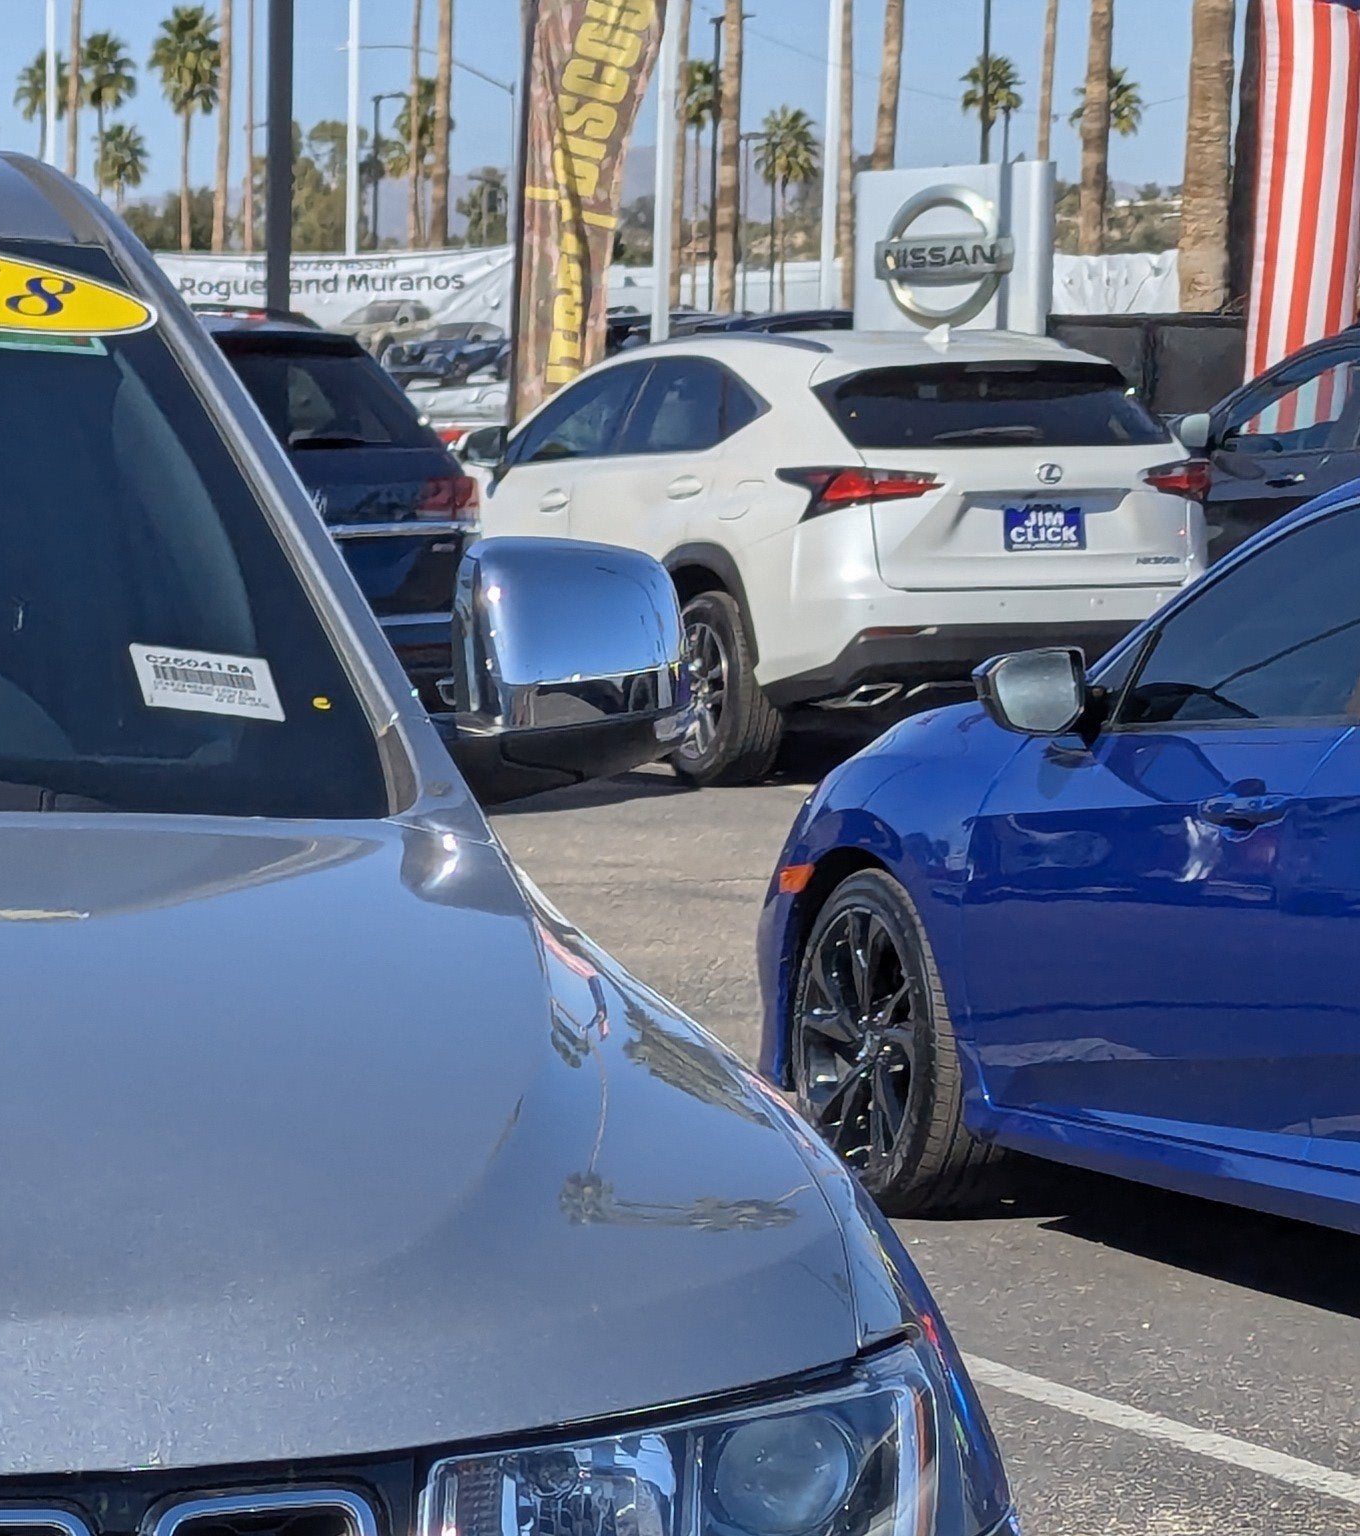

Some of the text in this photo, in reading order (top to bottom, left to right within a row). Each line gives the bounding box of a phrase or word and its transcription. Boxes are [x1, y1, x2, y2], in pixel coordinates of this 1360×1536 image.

[884, 244, 997, 271] NISSAN
[290, 273, 339, 295] and
[346, 273, 465, 293] Muranos
[1024, 510, 1065, 527] JIM
[1010, 525, 1077, 542] CLICK
